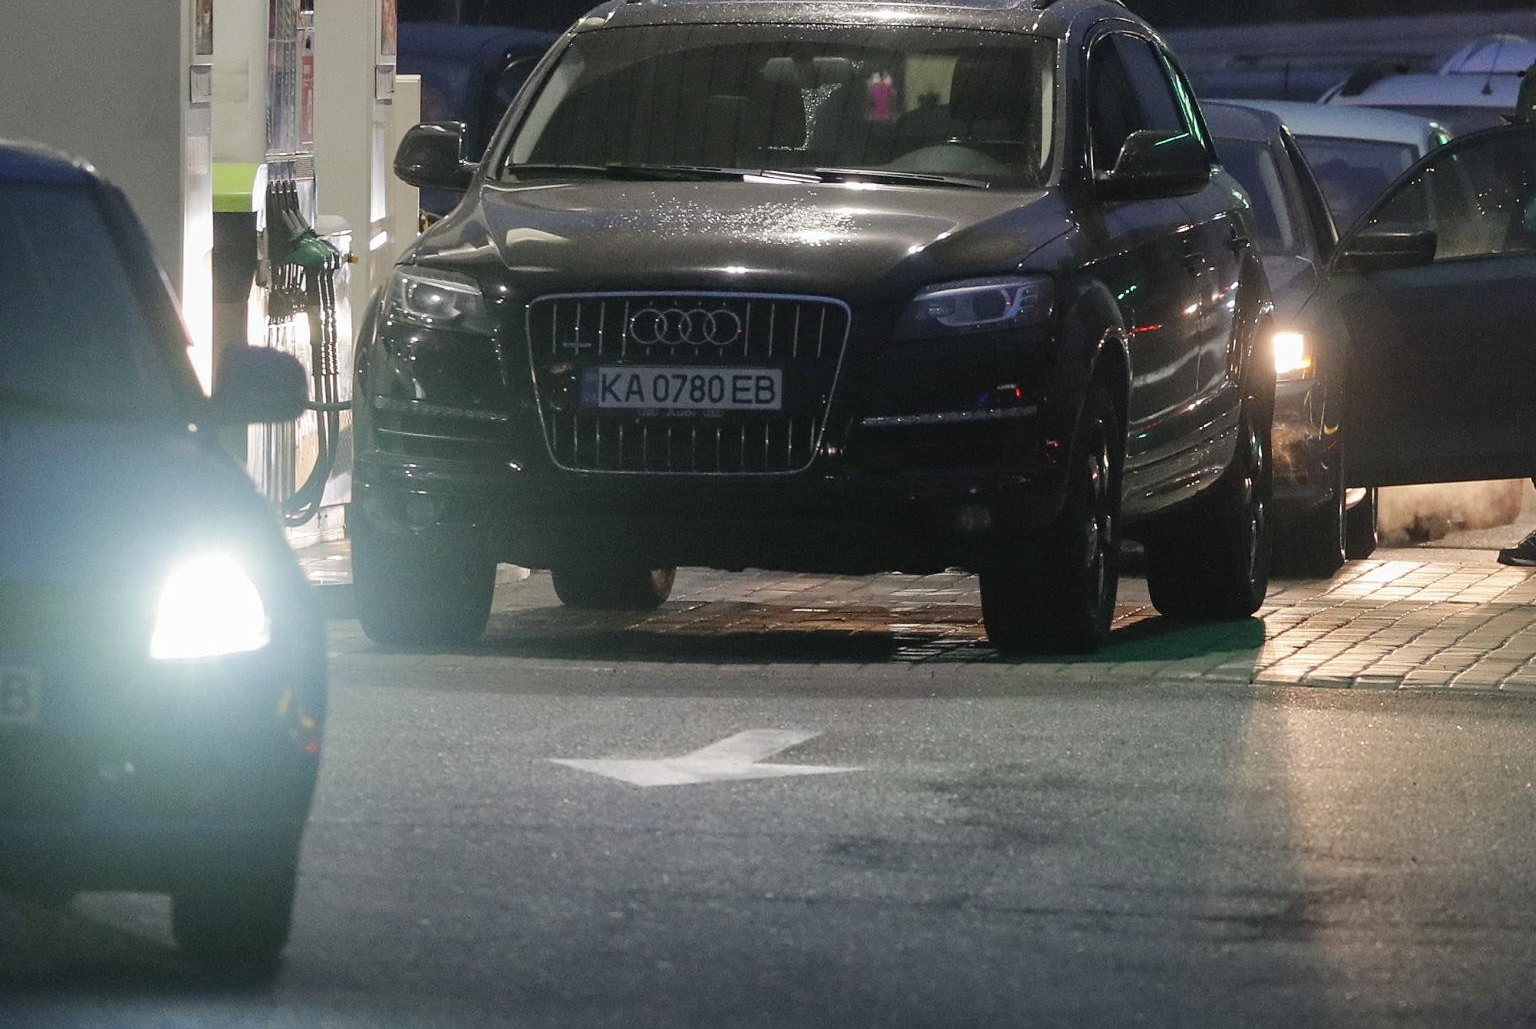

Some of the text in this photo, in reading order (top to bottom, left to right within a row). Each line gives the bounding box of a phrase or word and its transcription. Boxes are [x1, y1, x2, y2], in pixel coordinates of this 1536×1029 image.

[600, 373, 645, 404] KA
[652, 373, 726, 404] 0780
[731, 375, 777, 405] EB
